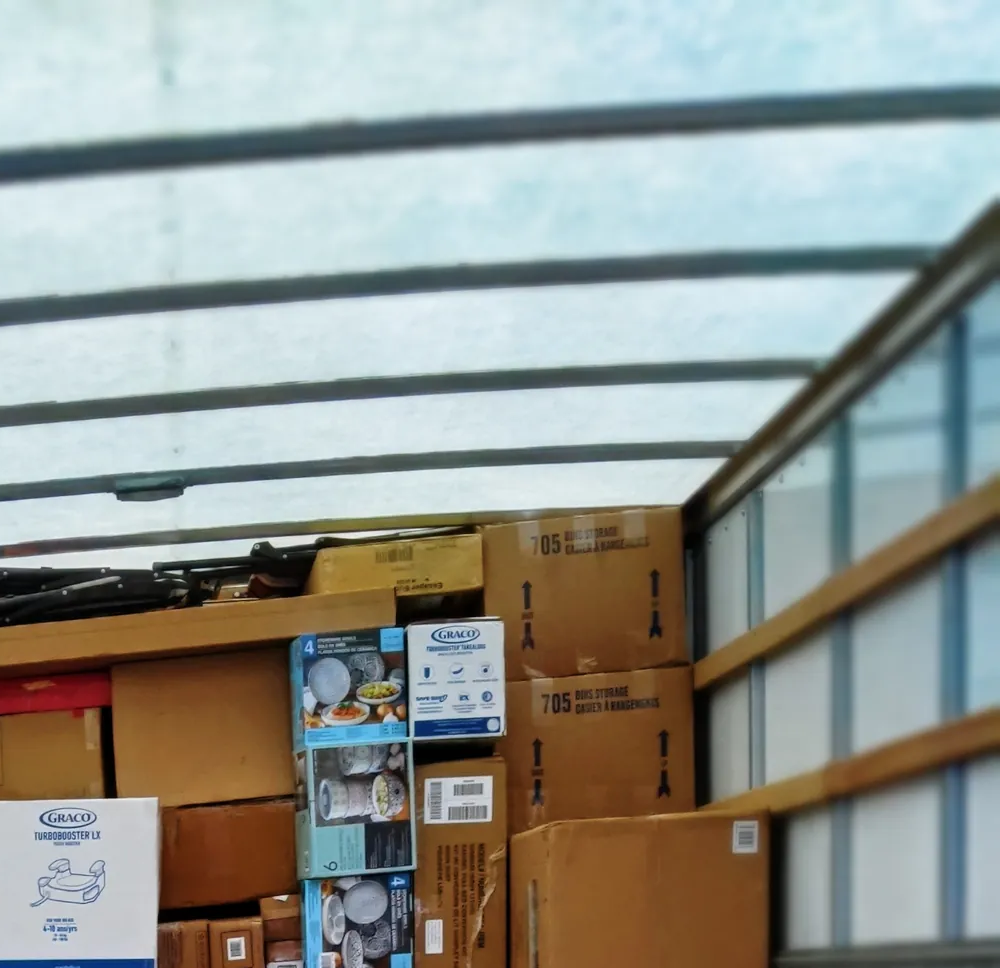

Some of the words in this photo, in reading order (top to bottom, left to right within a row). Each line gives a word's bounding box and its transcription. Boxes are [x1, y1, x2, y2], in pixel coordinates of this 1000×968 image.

[531, 533, 561, 555] 705
[439, 630, 475, 639] GRACO
[304, 640, 314, 655] 4
[541, 692, 571, 715] 705
[48, 812, 91, 823] GRACO
[35, 831, 90, 840] TURBOBOOSTER
[92, 831, 101, 839] LX
[323, 861, 338, 871] 6
[391, 876, 405, 886] 4
